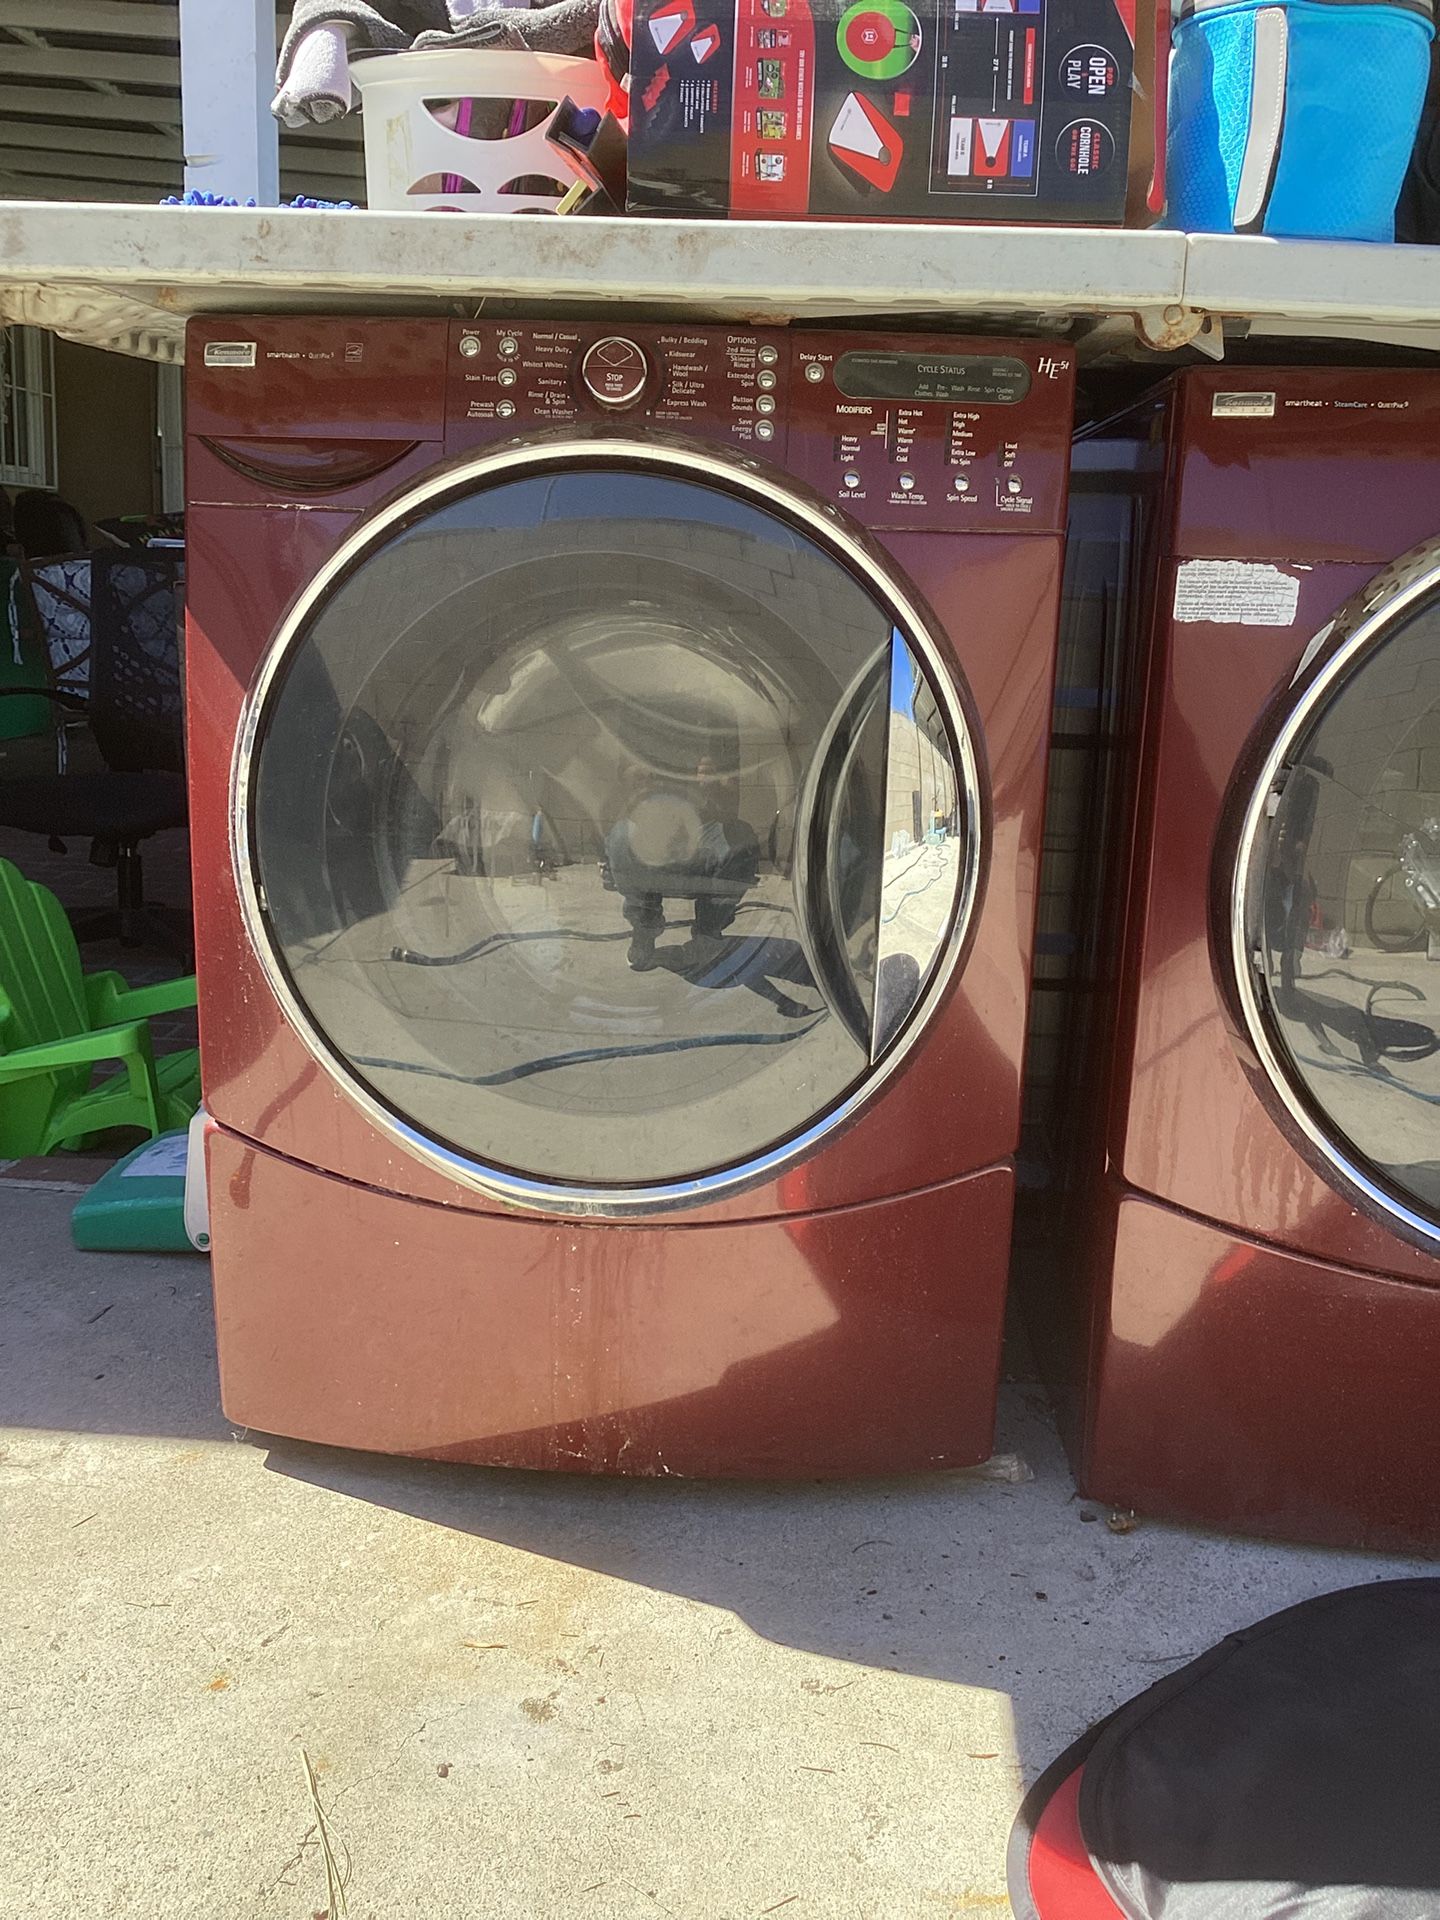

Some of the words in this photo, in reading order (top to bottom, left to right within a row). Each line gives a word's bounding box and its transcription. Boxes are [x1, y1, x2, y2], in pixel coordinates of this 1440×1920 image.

[1067, 60, 1081, 89] PLAY
[1088, 57, 1106, 95] OPEN
[1072, 129, 1078, 140] ON
[1078, 127, 1091, 175] CORNHOLE
[1092, 132, 1100, 170] CLASSIC
[462, 328, 480, 336] Power
[496, 329, 506, 337] My
[507, 329, 523, 337] Cycle
[660, 336, 678, 344] Bulky
[683, 337, 708, 346] Bedding
[554, 346, 569, 354] Duty
[730, 355, 756, 363] Skincare
[800, 353, 817, 362] Delay
[544, 361, 563, 369] Whites
[672, 364, 703, 372] Handwash
[733, 361, 750, 369] Rinse
[727, 372, 755, 380] Extended
[538, 378, 562, 386] Sanitary
[740, 380, 754, 388] Spin
[671, 387, 696, 395] Delicate
[984, 386, 995, 394] Spin
[552, 398, 566, 406] Spin
[666, 399, 689, 407] Express
[1284, 399, 1323, 407] smartheat
[1333, 400, 1368, 408] SteamCare
[533, 407, 550, 415] Clean
[551, 408, 574, 416] Washer
[836, 404, 873, 415] MODIFIERS
[953, 411, 966, 419] Extra
[967, 412, 980, 421] High
[731, 425, 752, 433] Energy
[952, 421, 965, 429] High
[739, 432, 752, 440] Plus
[841, 435, 858, 443] Heavy
[841, 444, 860, 452] Normal
[840, 454, 854, 463] Light
[959, 458, 971, 466] Spin
[838, 490, 850, 498] Soil
[851, 491, 866, 499] Level
[891, 491, 907, 499] Wash
[908, 492, 924, 501] Temp
[946, 493, 960, 502] Spin
[960, 494, 978, 503] Speed
[1000, 495, 1015, 504] Cycle
[1015, 496, 1033, 505] Signal
